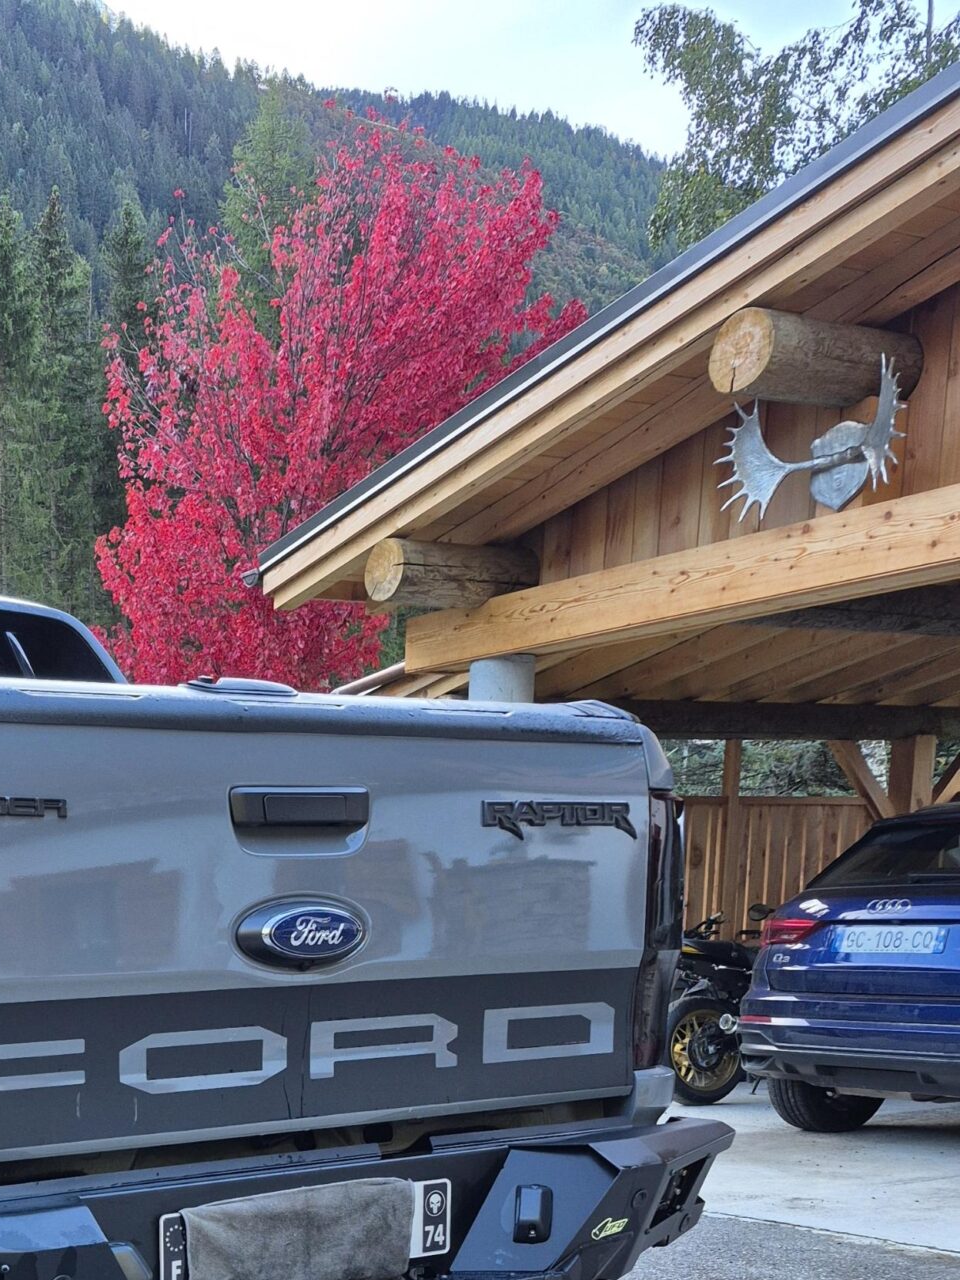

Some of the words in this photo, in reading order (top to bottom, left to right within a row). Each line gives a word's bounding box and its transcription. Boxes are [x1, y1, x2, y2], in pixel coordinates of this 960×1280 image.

[481, 800, 638, 840] RAPTOR
[290, 916, 345, 947] Ford
[424, 1223, 445, 1247] 74
